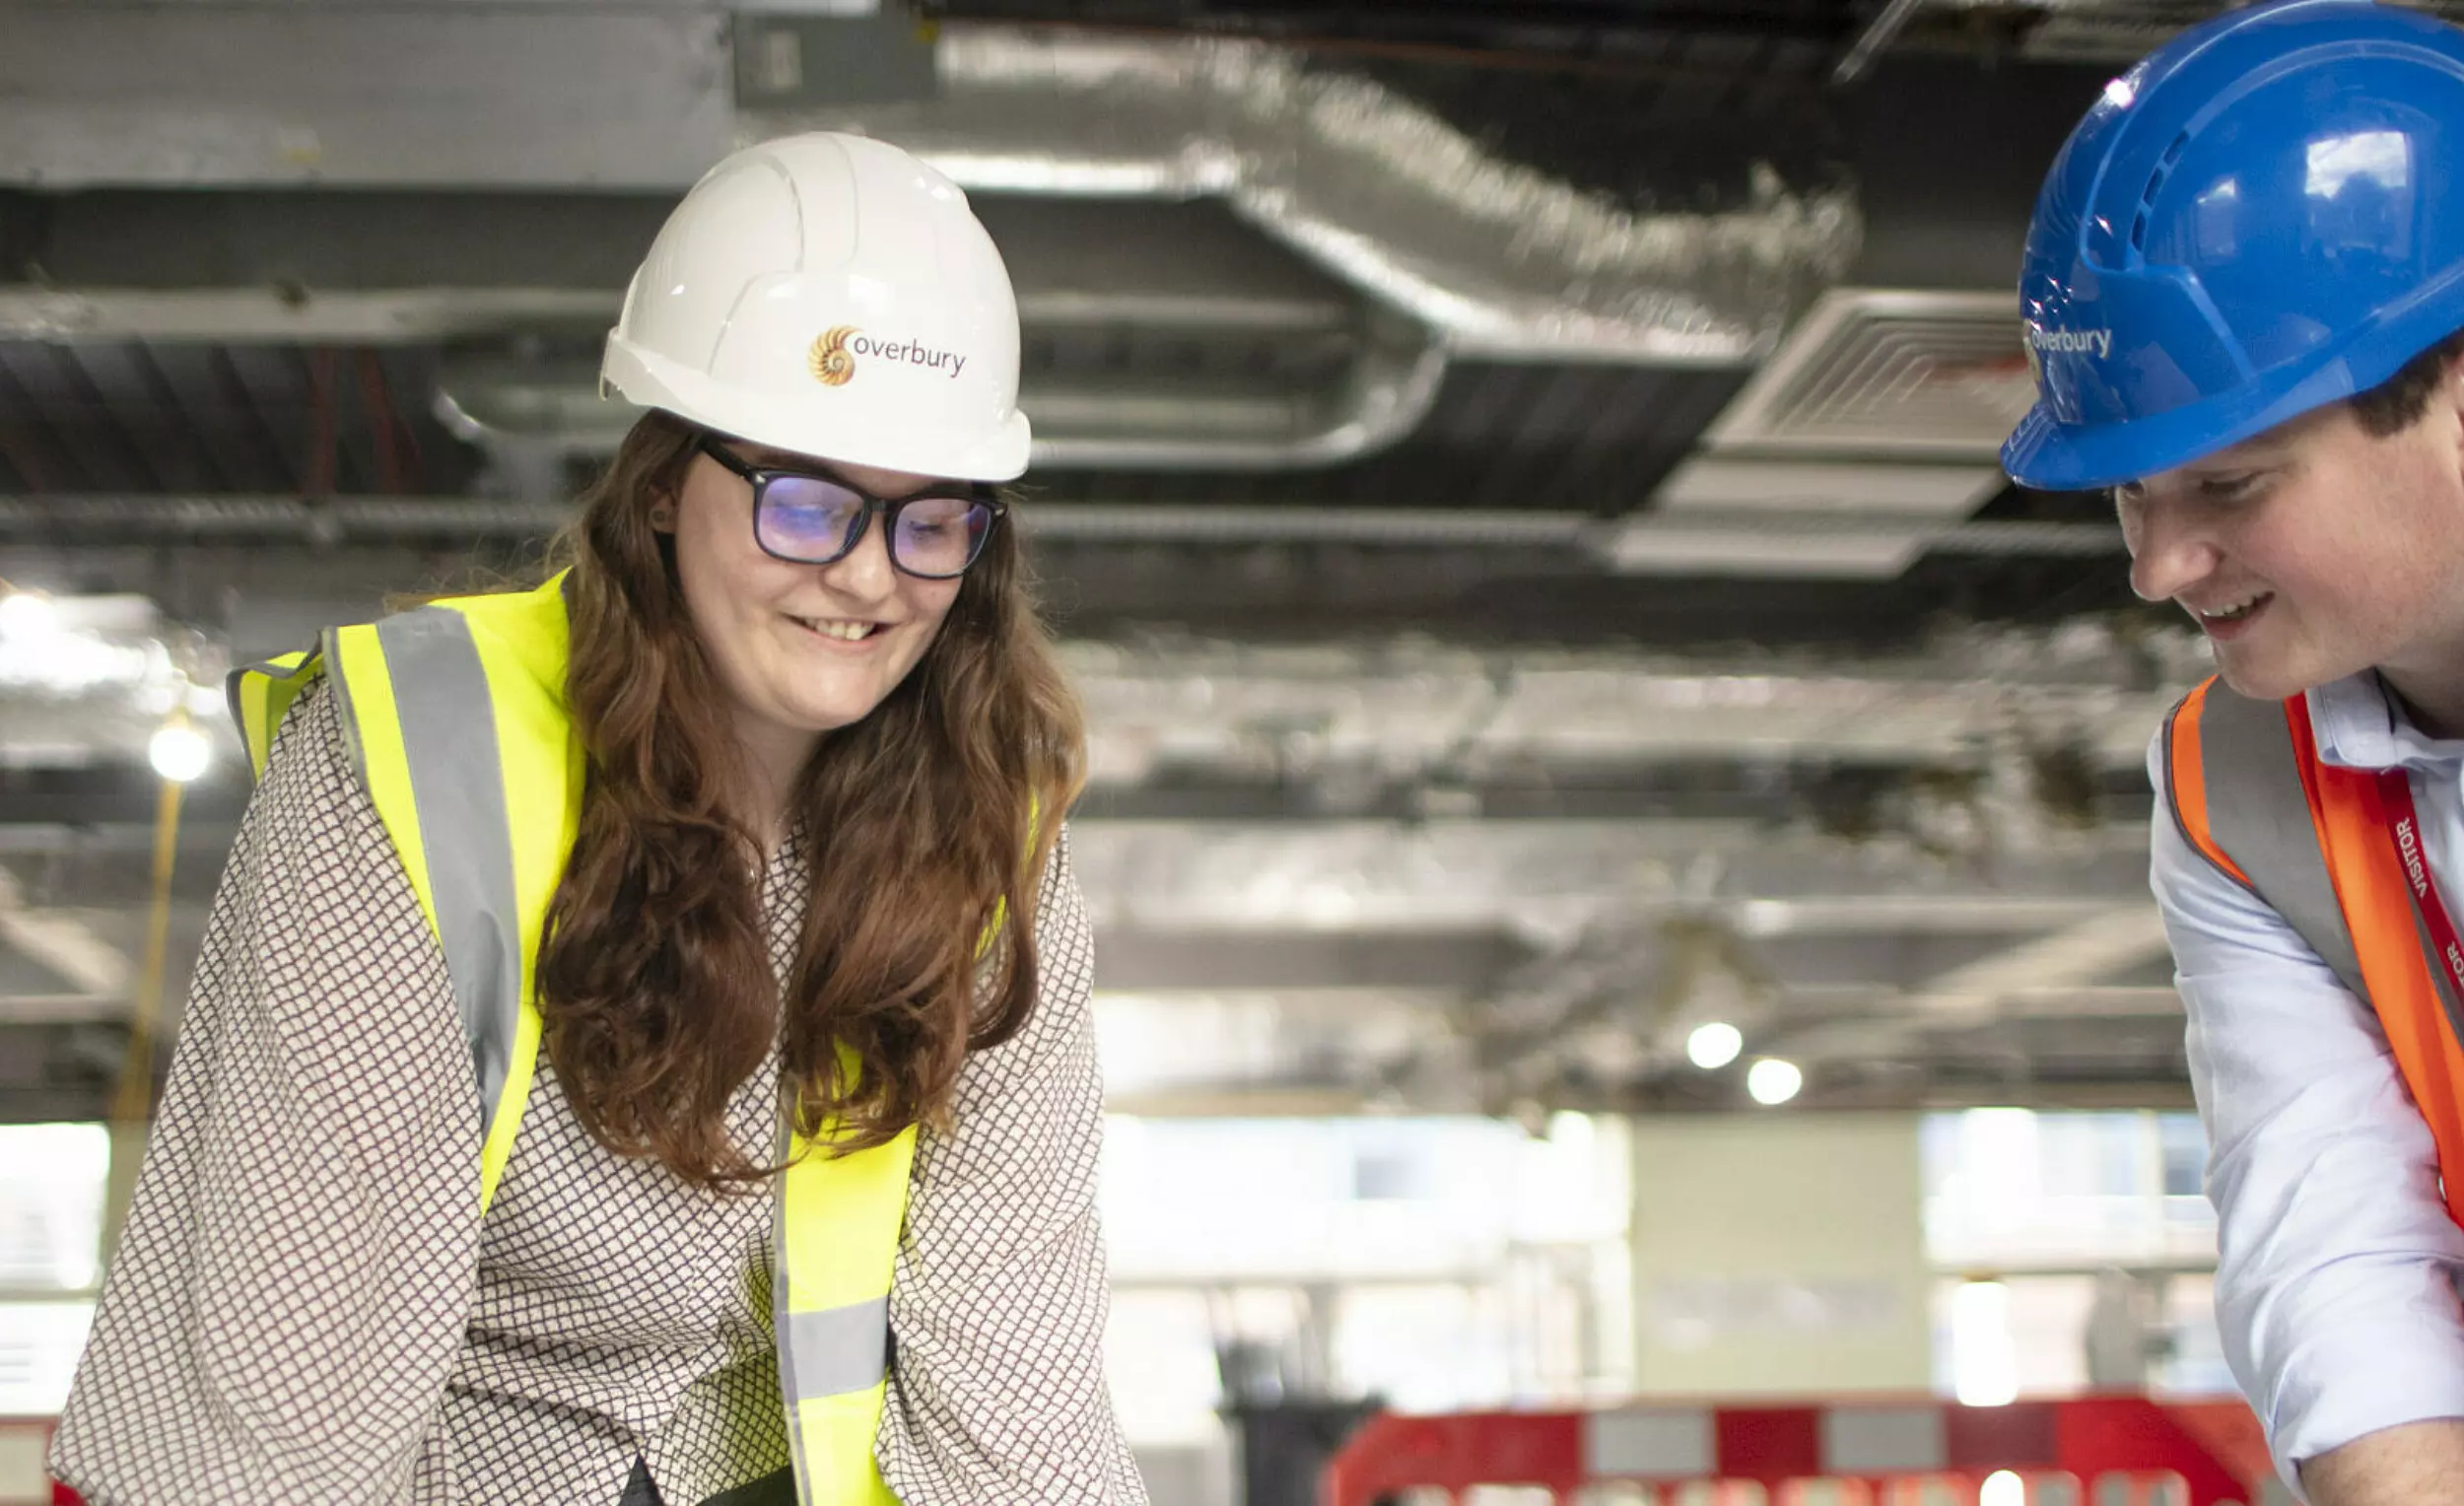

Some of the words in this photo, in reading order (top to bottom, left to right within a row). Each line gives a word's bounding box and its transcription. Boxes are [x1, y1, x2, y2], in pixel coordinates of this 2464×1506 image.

[854, 336, 966, 377] overbury
[2031, 324, 2112, 359] overbury
[2396, 817, 2427, 898] VISITOR
